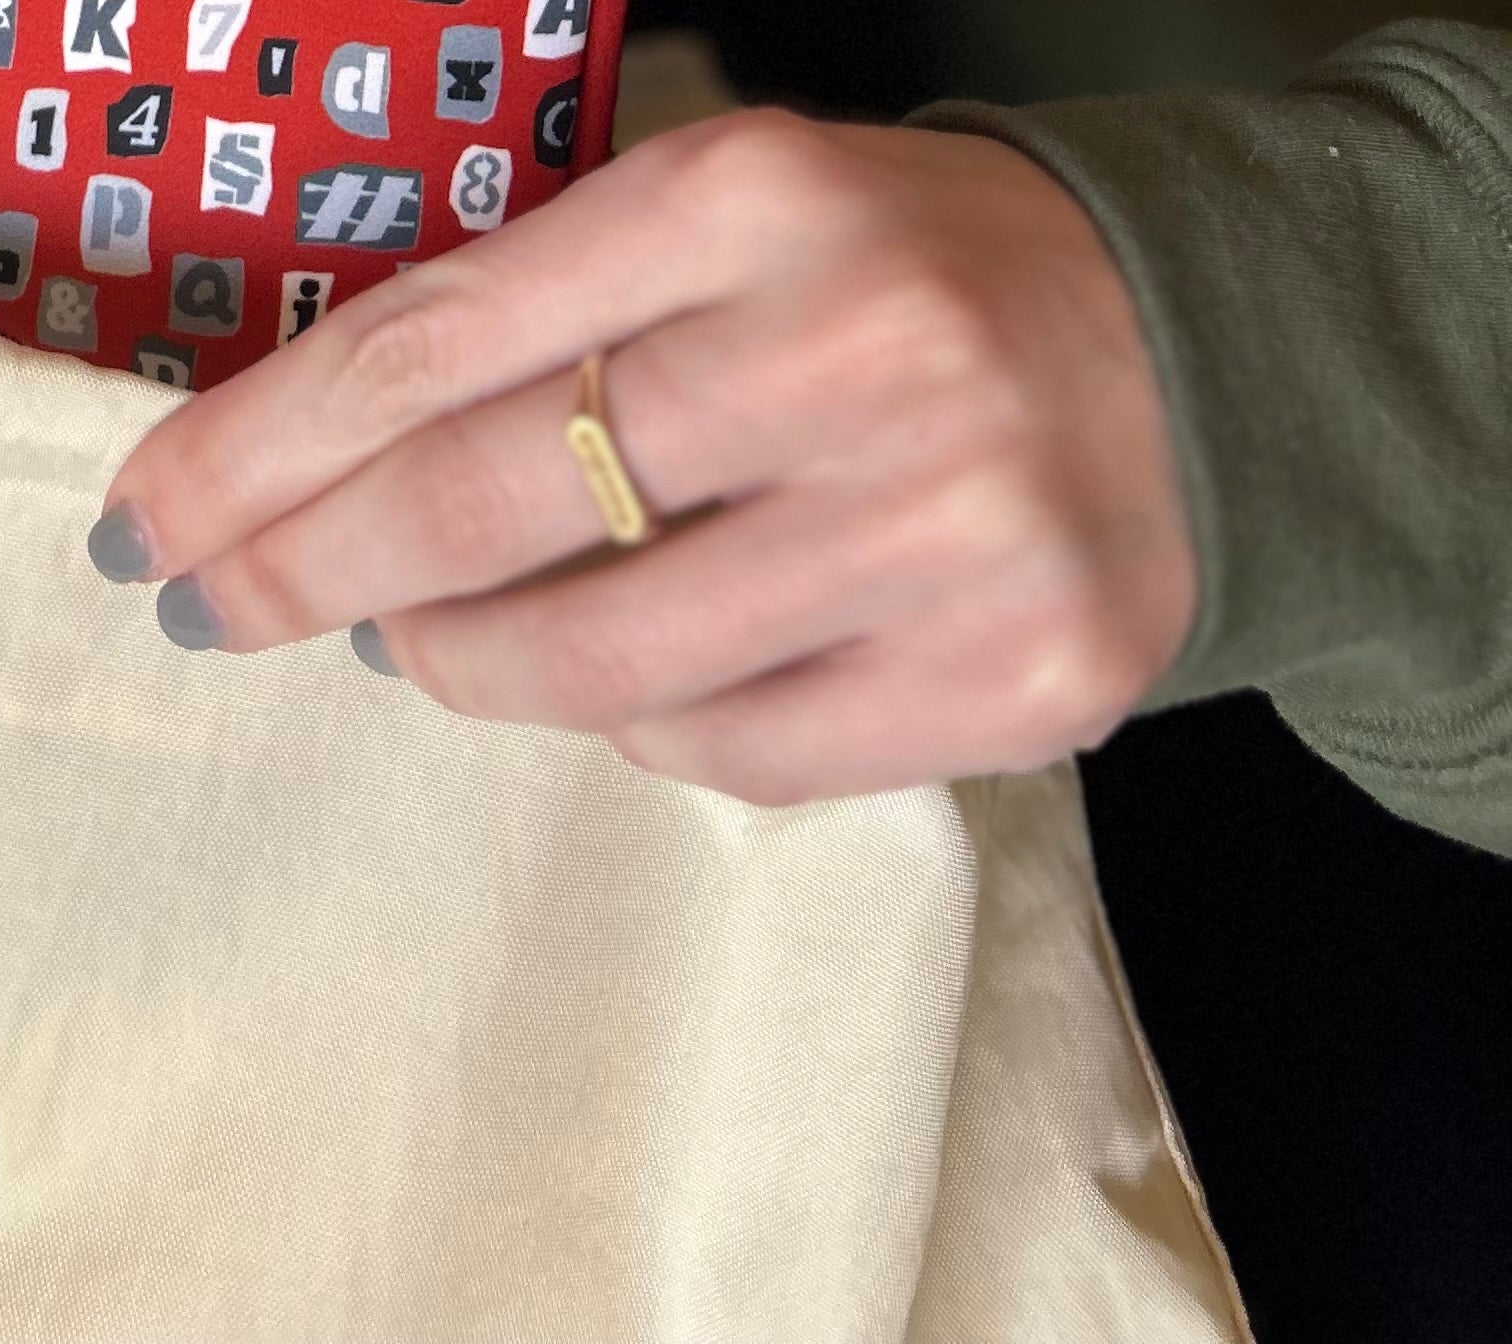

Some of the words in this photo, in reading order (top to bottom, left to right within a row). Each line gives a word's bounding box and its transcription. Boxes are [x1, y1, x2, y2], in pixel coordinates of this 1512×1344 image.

[199, 4, 241, 56] 7
[335, 52, 385, 113] d
[31, 106, 56, 156] 1
[119, 96, 160, 146] 4
[458, 152, 500, 214] 8
[46, 282, 89, 334] &
[176, 263, 237, 326] Q
